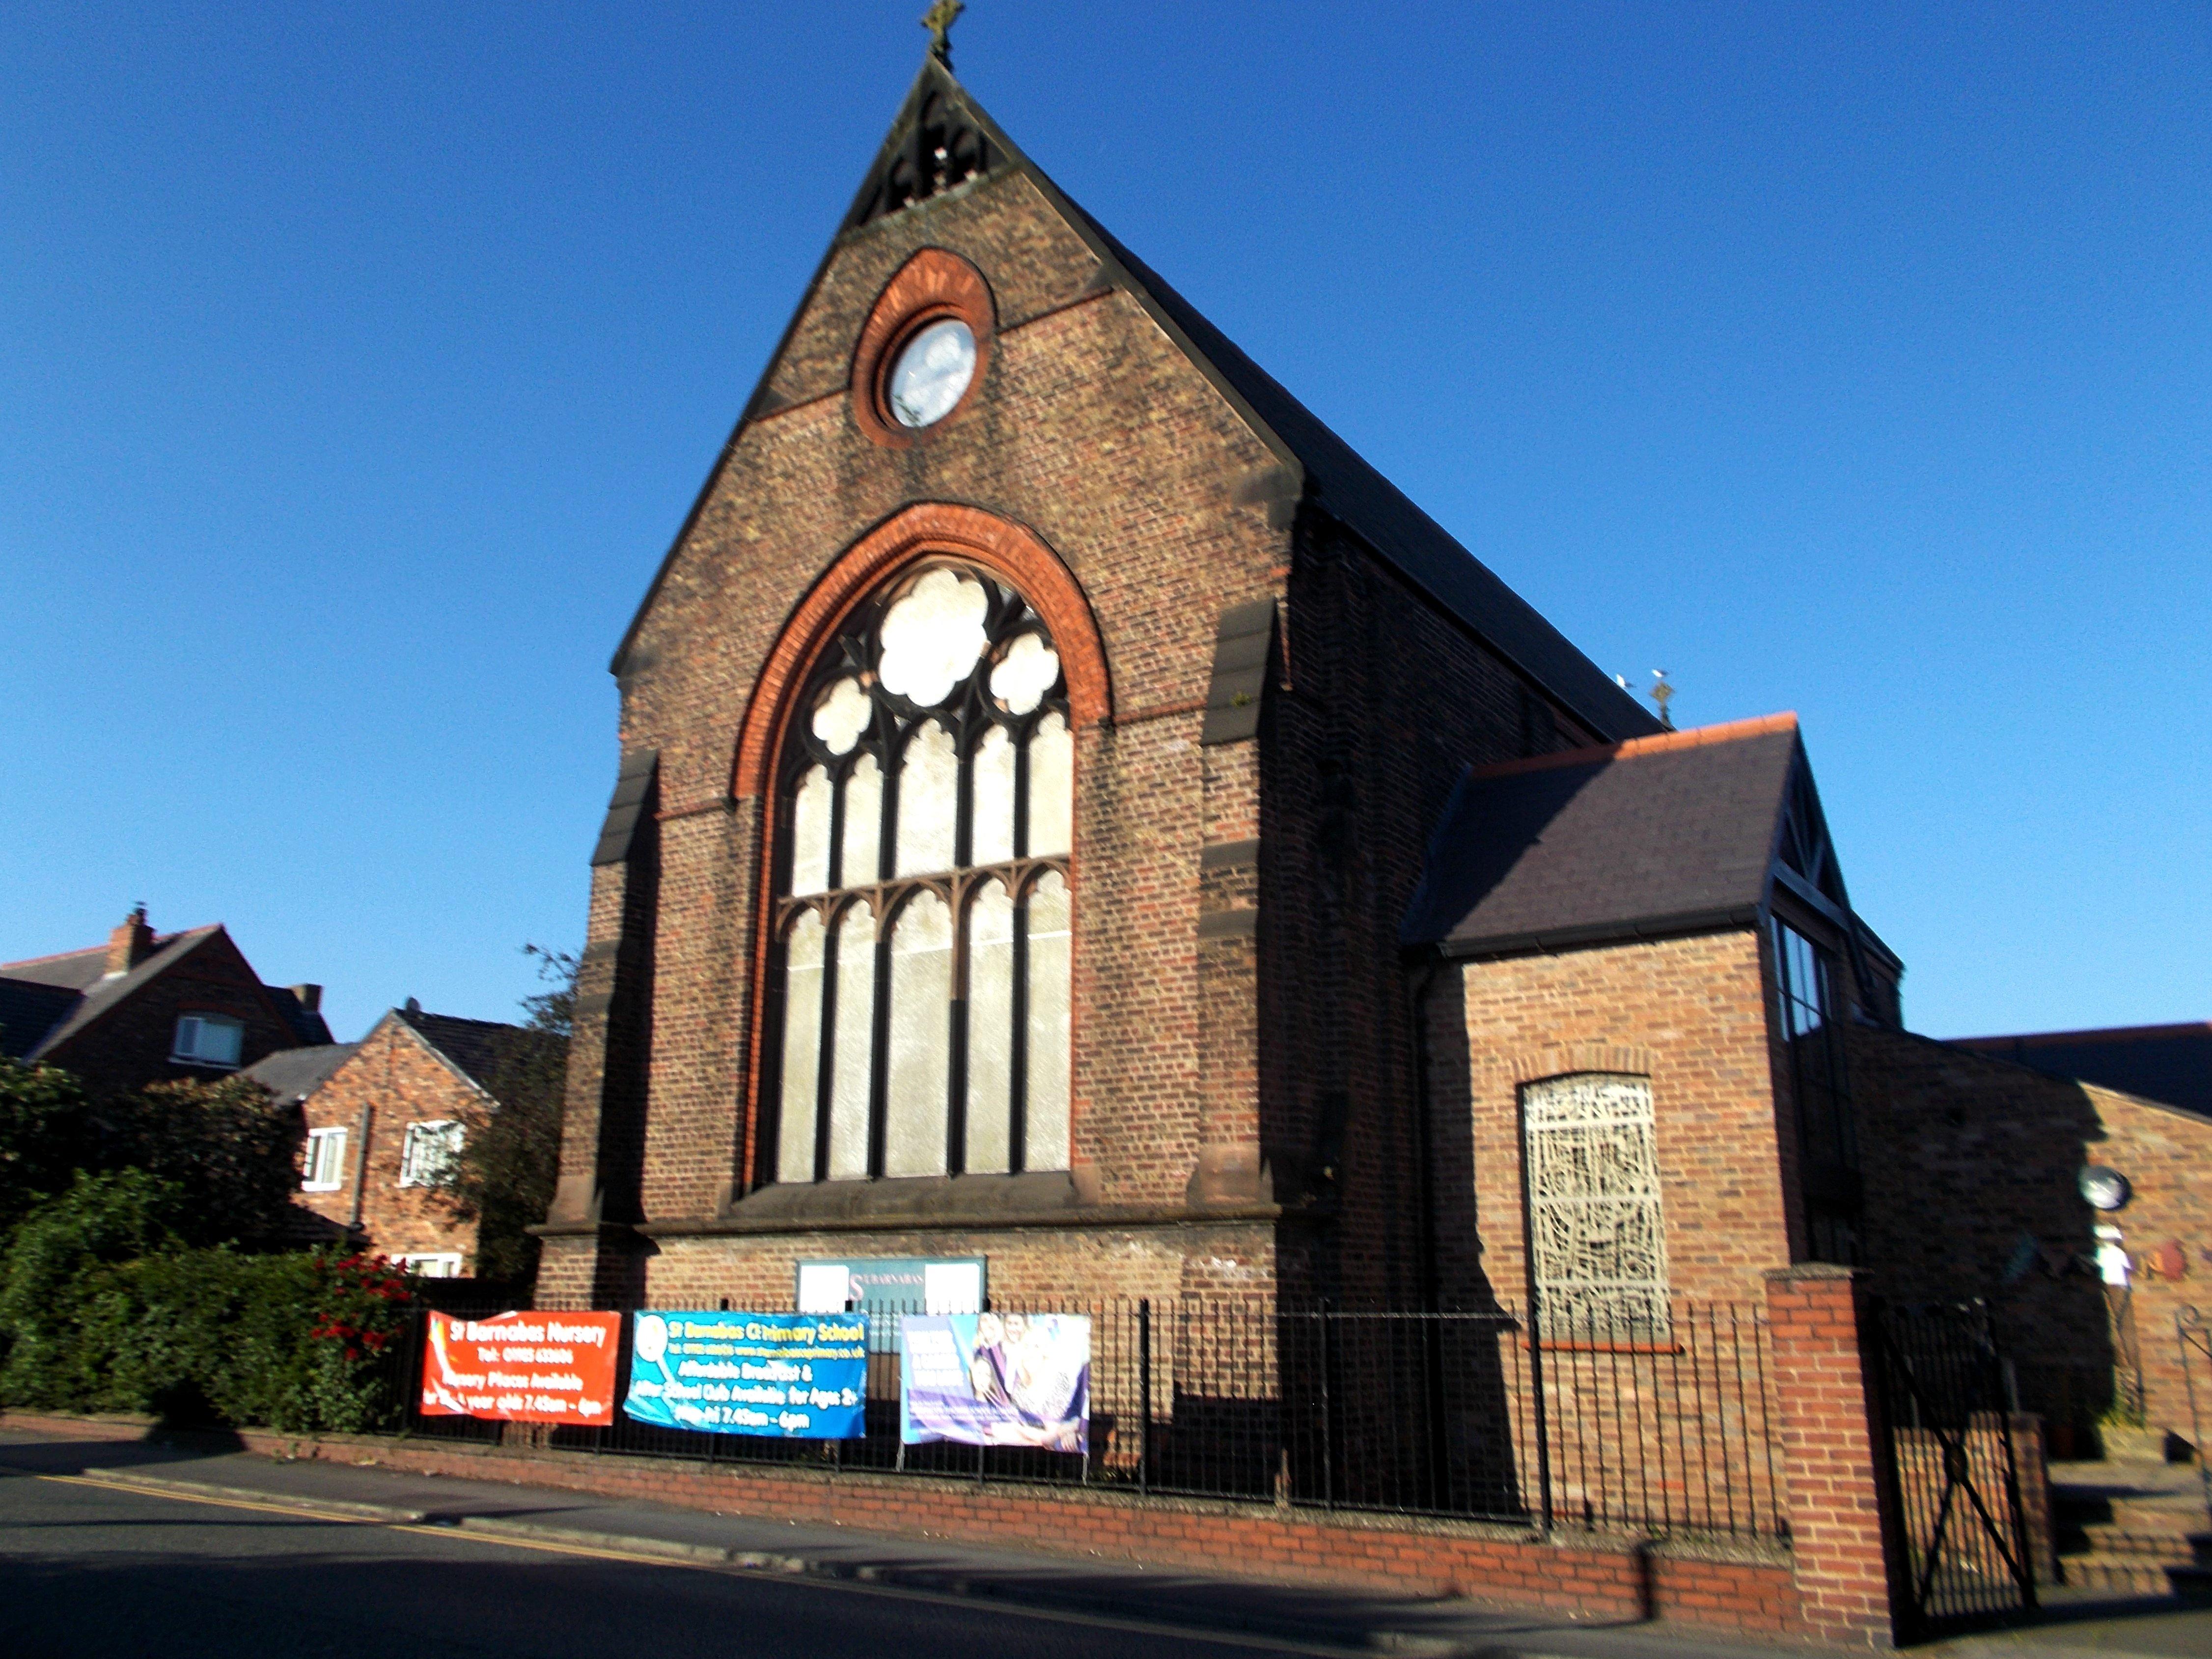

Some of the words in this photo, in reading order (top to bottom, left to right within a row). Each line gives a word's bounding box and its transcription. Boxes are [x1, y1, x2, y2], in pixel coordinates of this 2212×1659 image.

[450, 1321, 465, 1341] St
[466, 1320, 545, 1343] Barnabas
[547, 1322, 606, 1349] Nursery
[668, 1321, 683, 1338] St
[684, 1320, 744, 1340] Barnabas
[761, 1323, 816, 1345] Primary
[818, 1322, 865, 1341] School
[487, 1370, 529, 1388] Places
[530, 1372, 583, 1392] Available
[678, 1360, 740, 1379] Affordable
[741, 1362, 801, 1381] Breakfast
[664, 1380, 702, 1400] School
[702, 1382, 730, 1402] Club
[731, 1384, 786, 1405] Available
[809, 1386, 840, 1410] Ages
[778, 1410, 810, 1431] 6pm
